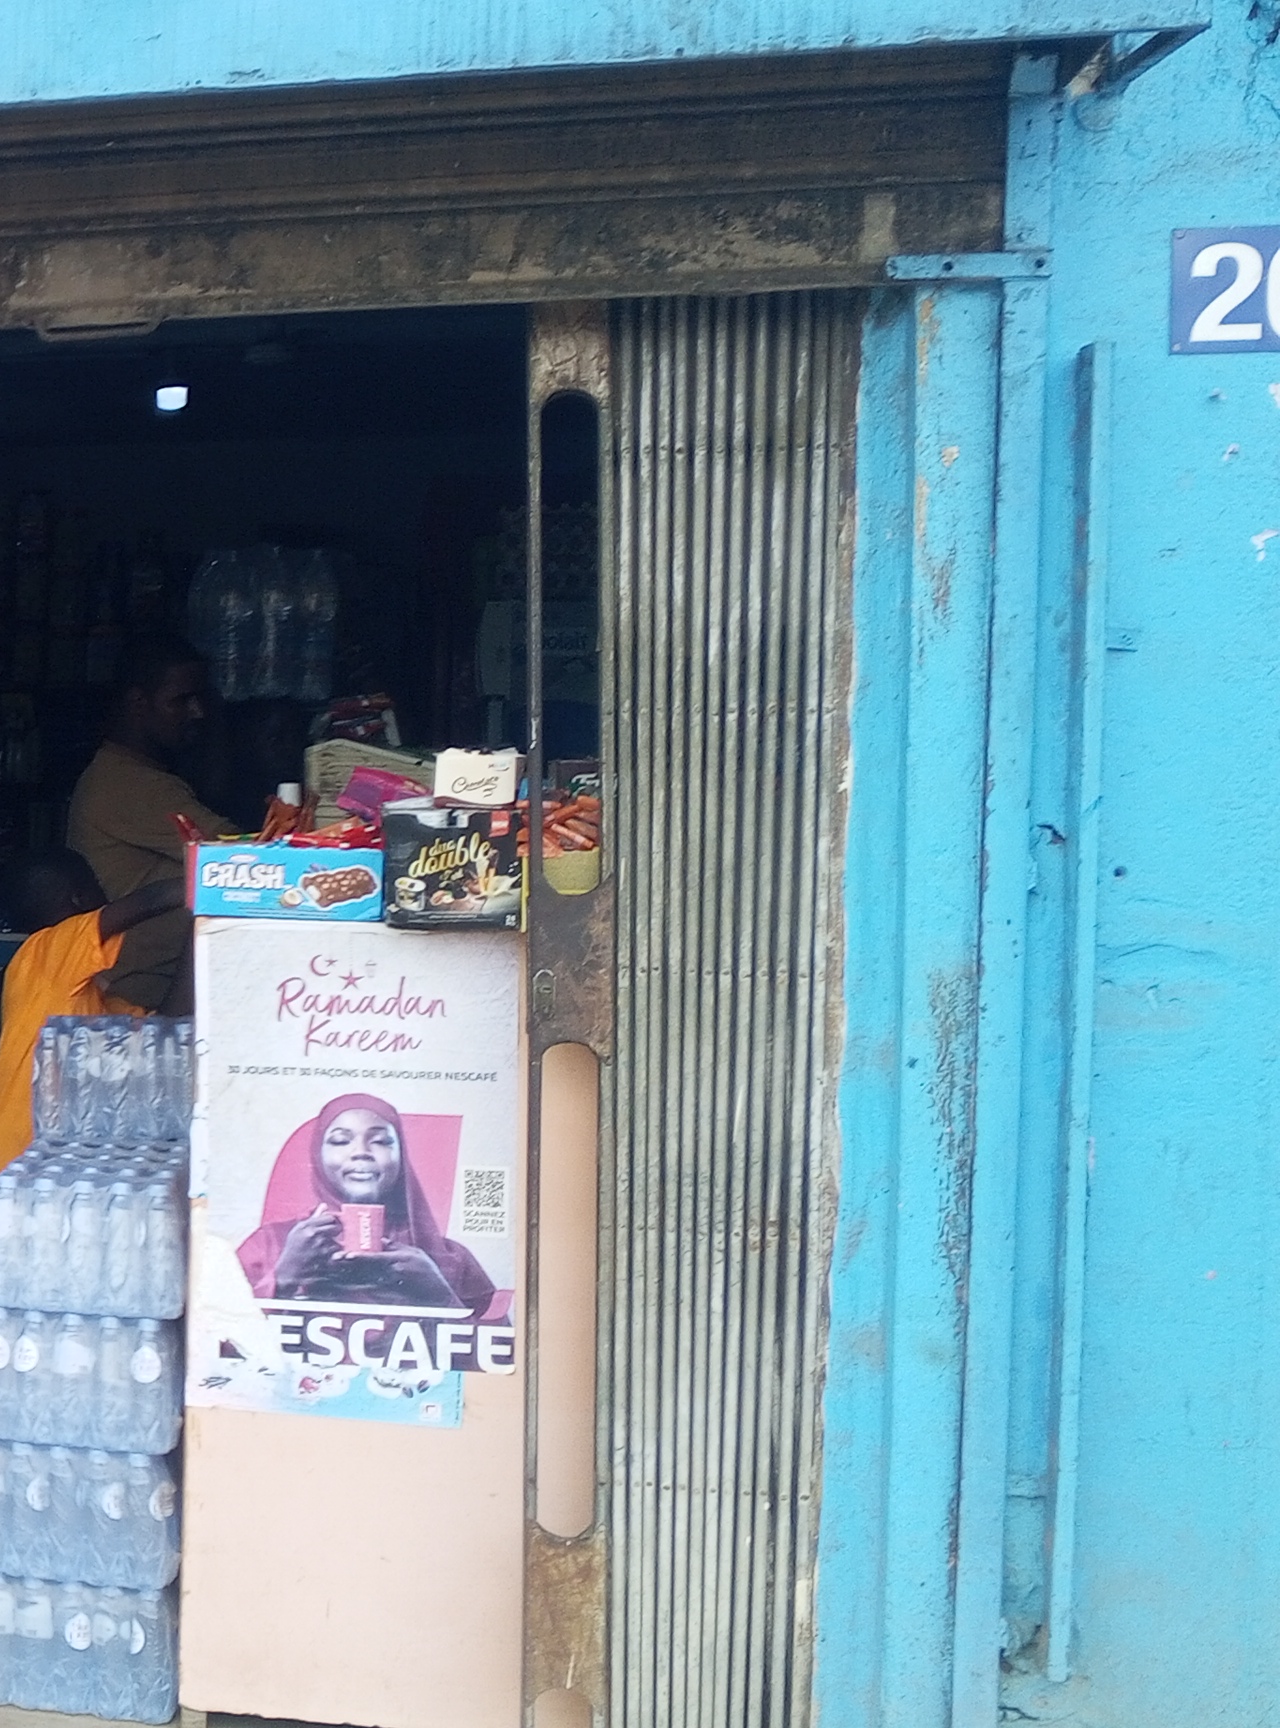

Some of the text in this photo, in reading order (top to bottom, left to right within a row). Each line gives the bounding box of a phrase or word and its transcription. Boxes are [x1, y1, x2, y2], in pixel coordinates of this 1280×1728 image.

[1190, 242, 1280, 342] 2
[202, 862, 286, 890] CRASH
[407, 832, 491, 878] double
[276, 976, 447, 1022] Ramadan
[304, 1014, 423, 1057] Kareem
[242, 1066, 280, 1075] JOURS
[282, 1067, 298, 1076] ET
[314, 1068, 359, 1078] FAÇONS
[361, 1069, 377, 1079] DE
[380, 1069, 442, 1080] SAVOURER
